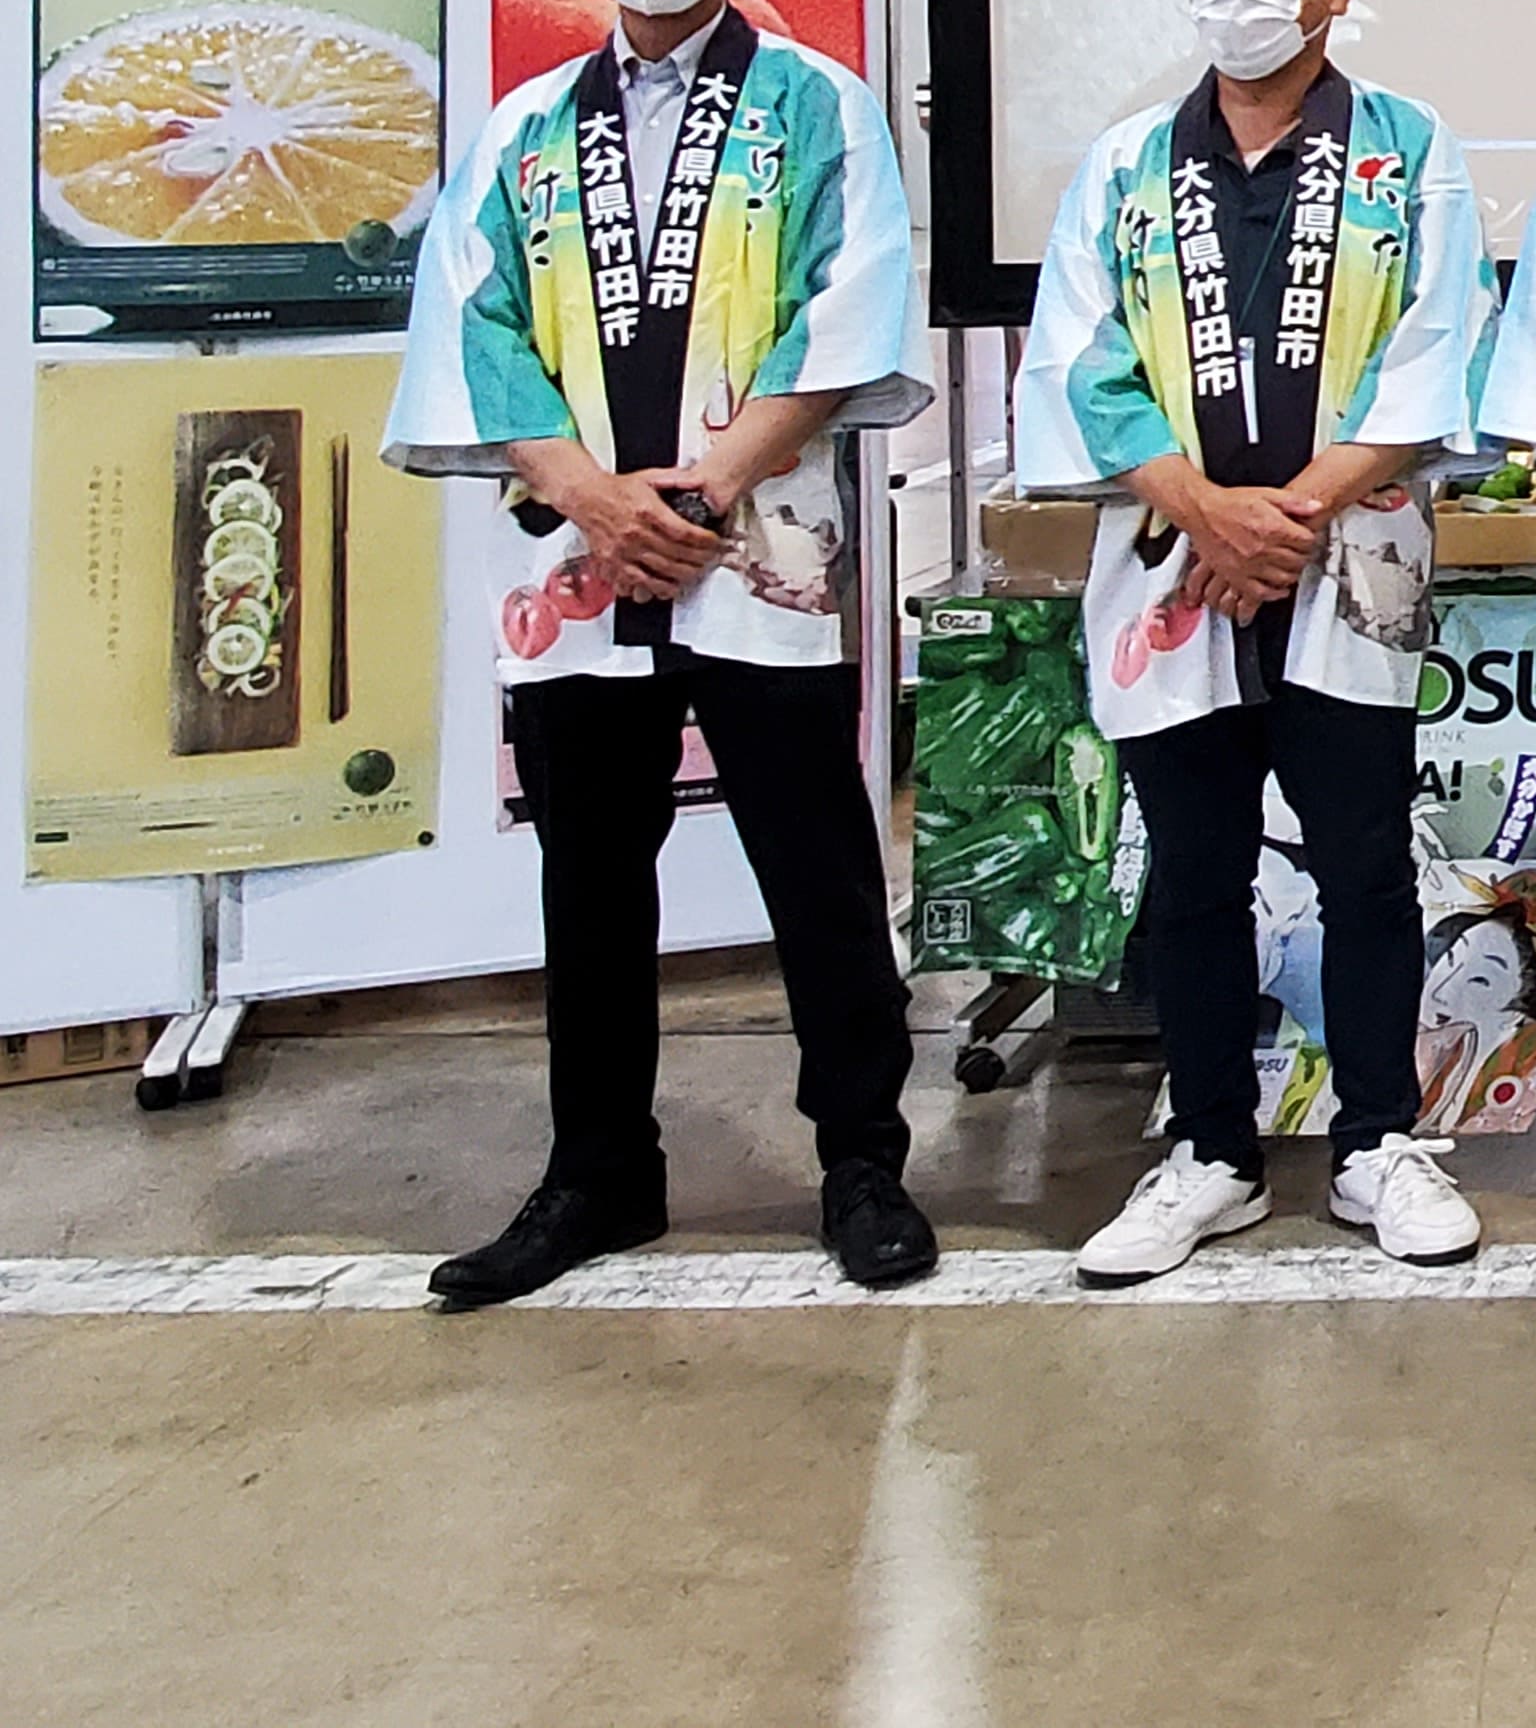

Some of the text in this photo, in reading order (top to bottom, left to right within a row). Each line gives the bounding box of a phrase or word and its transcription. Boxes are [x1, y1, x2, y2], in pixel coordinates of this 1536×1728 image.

[578, 111, 640, 348] 大分県竹田市
[647, 72, 738, 310] 大分県竹田市
[1171, 157, 1238, 398] 大分県竹田市
[1275, 131, 1345, 370] 大分県竹田市
